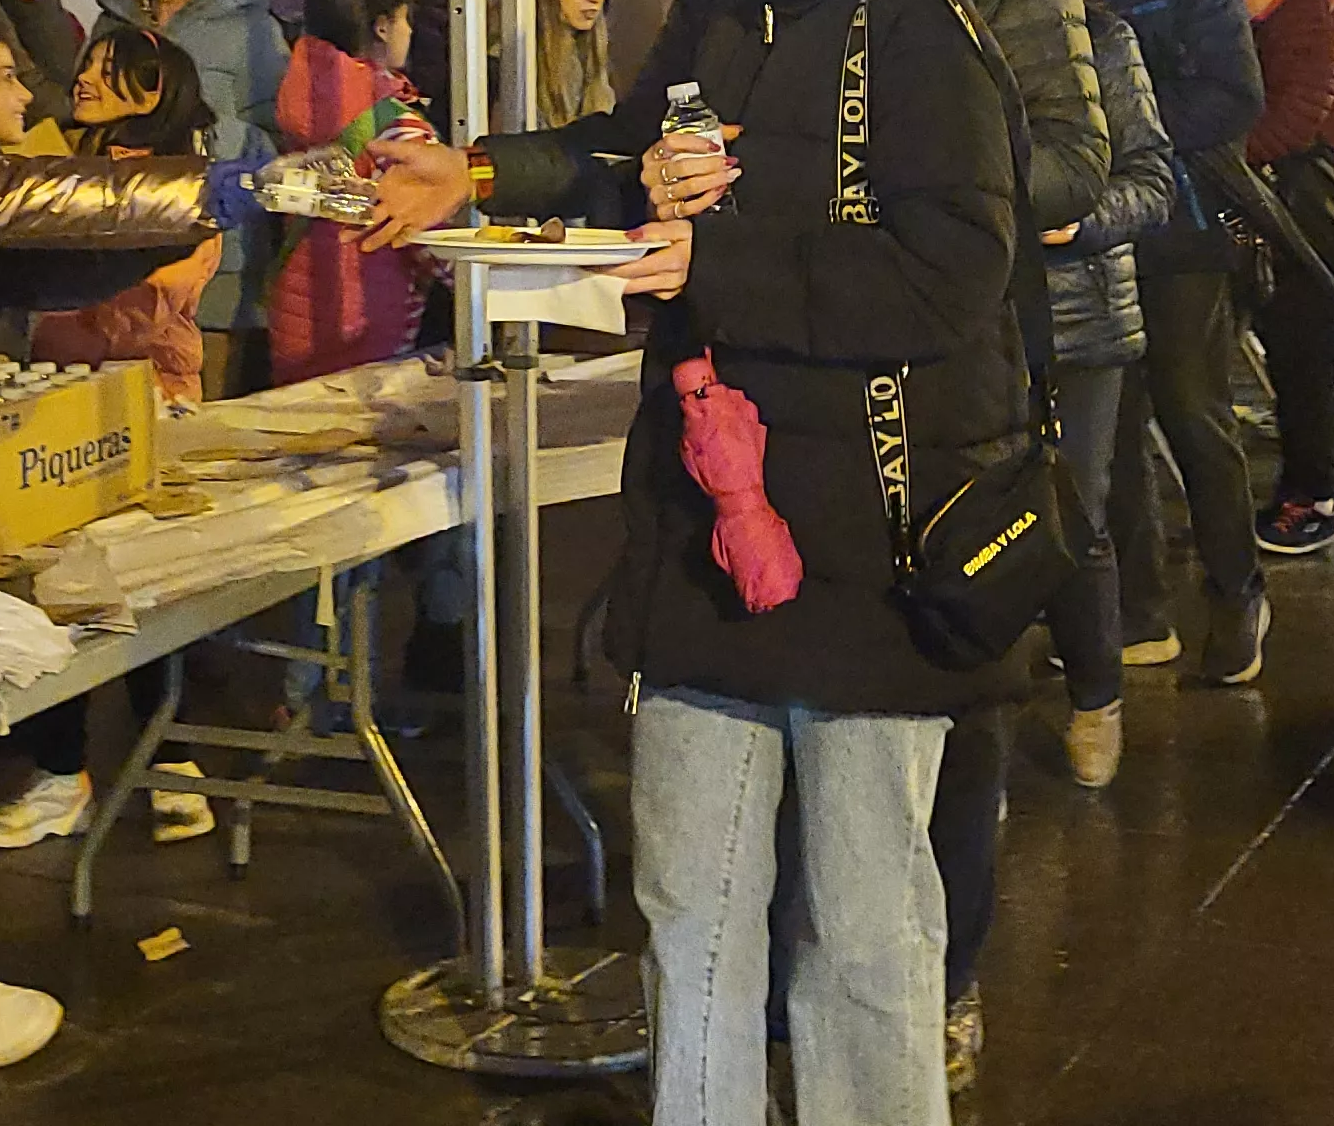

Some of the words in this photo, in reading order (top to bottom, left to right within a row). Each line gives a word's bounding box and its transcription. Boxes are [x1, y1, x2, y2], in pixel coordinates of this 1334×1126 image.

[842, 50, 866, 144] LOLA
[18, 426, 132, 490] Piqueras
[1006, 511, 1038, 541] LOLA
